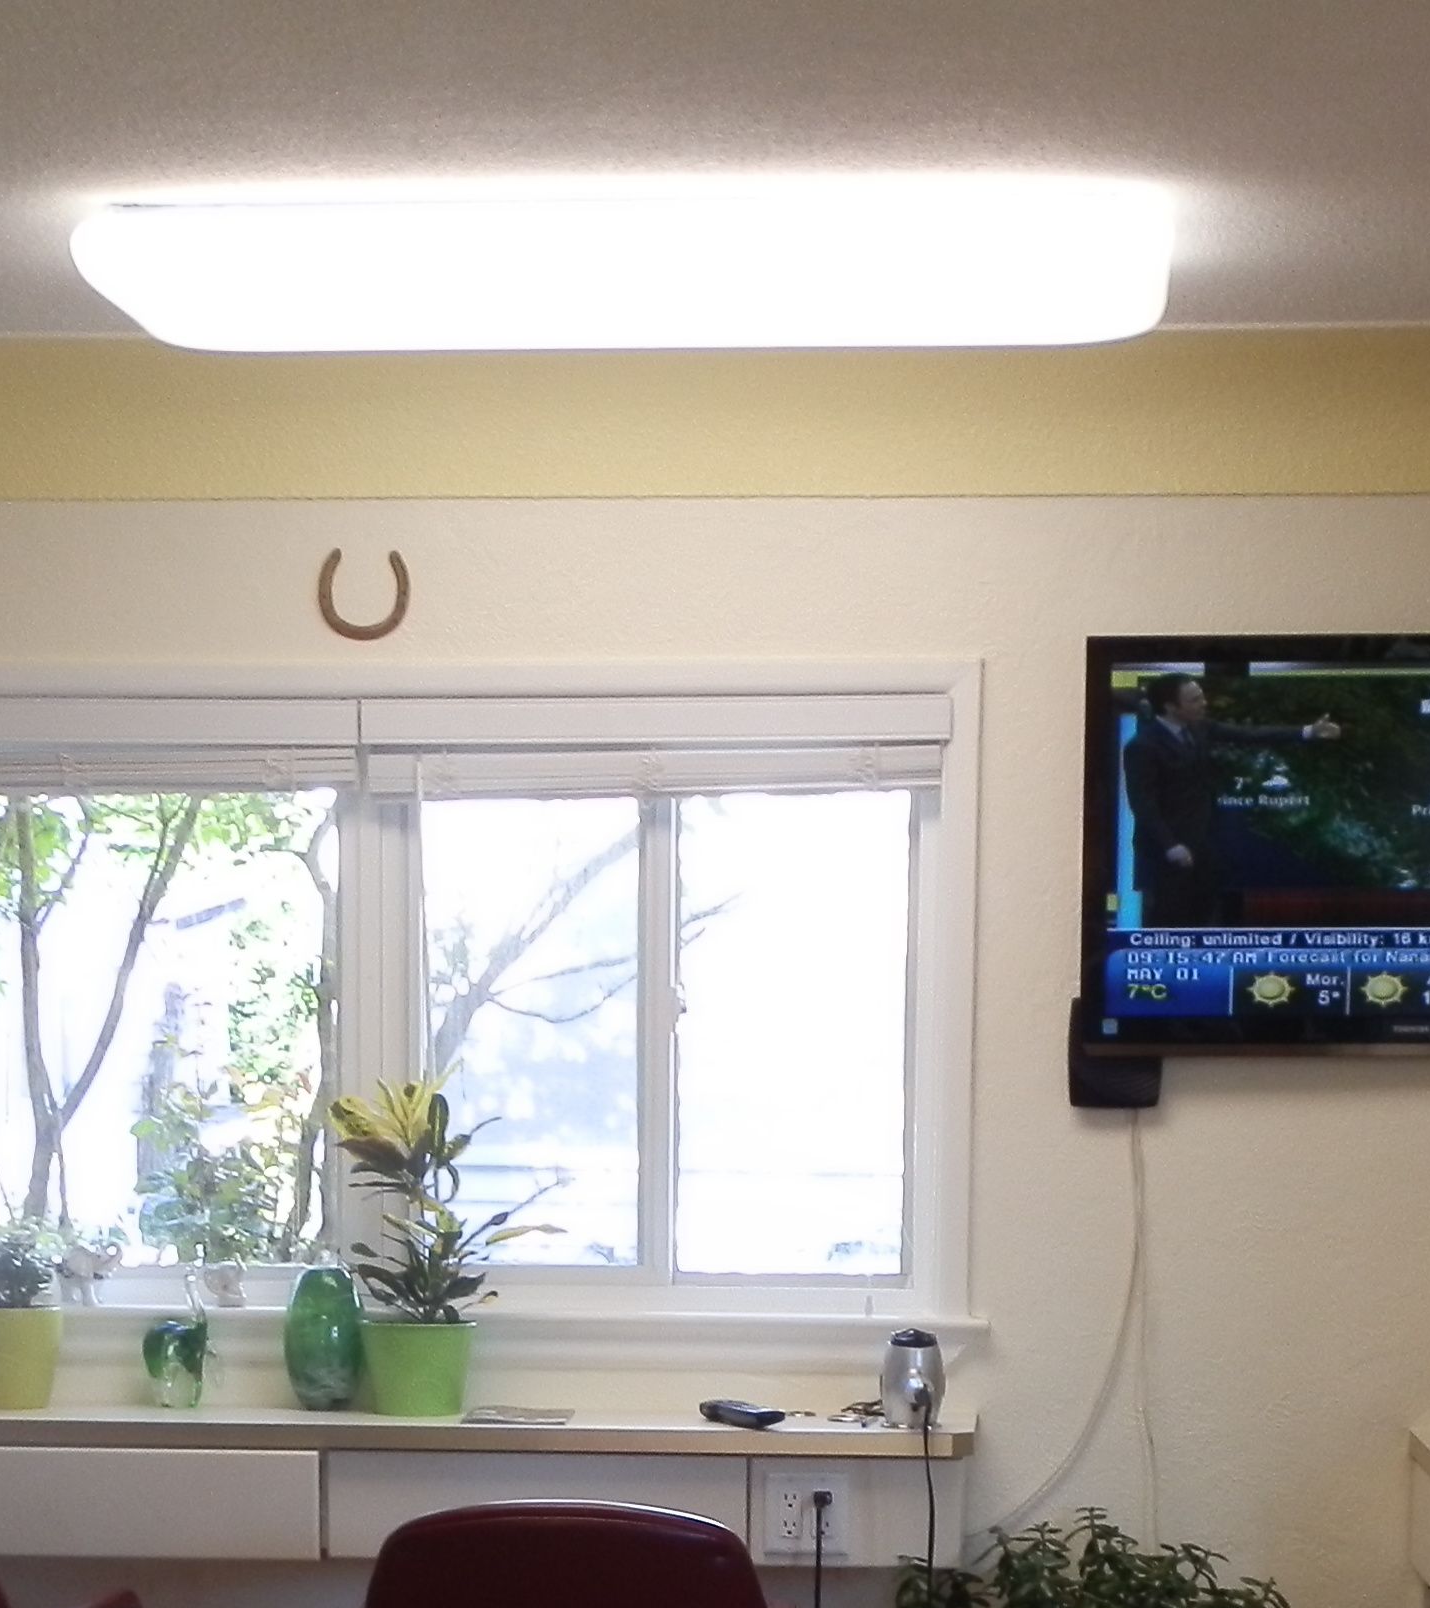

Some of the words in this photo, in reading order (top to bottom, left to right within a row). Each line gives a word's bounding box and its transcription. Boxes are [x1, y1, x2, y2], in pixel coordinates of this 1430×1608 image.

[1130, 932, 1196, 947] Ceiling:
[1202, 932, 1283, 946] unlimited
[1305, 932, 1384, 947] Visibility:
[1232, 951, 1258, 964] AM
[1267, 951, 1346, 963] Forecast
[1354, 951, 1378, 963] for
[1127, 967, 1163, 981] MAY
[1176, 967, 1199, 981] 01
[1306, 972, 1345, 986] Mor.
